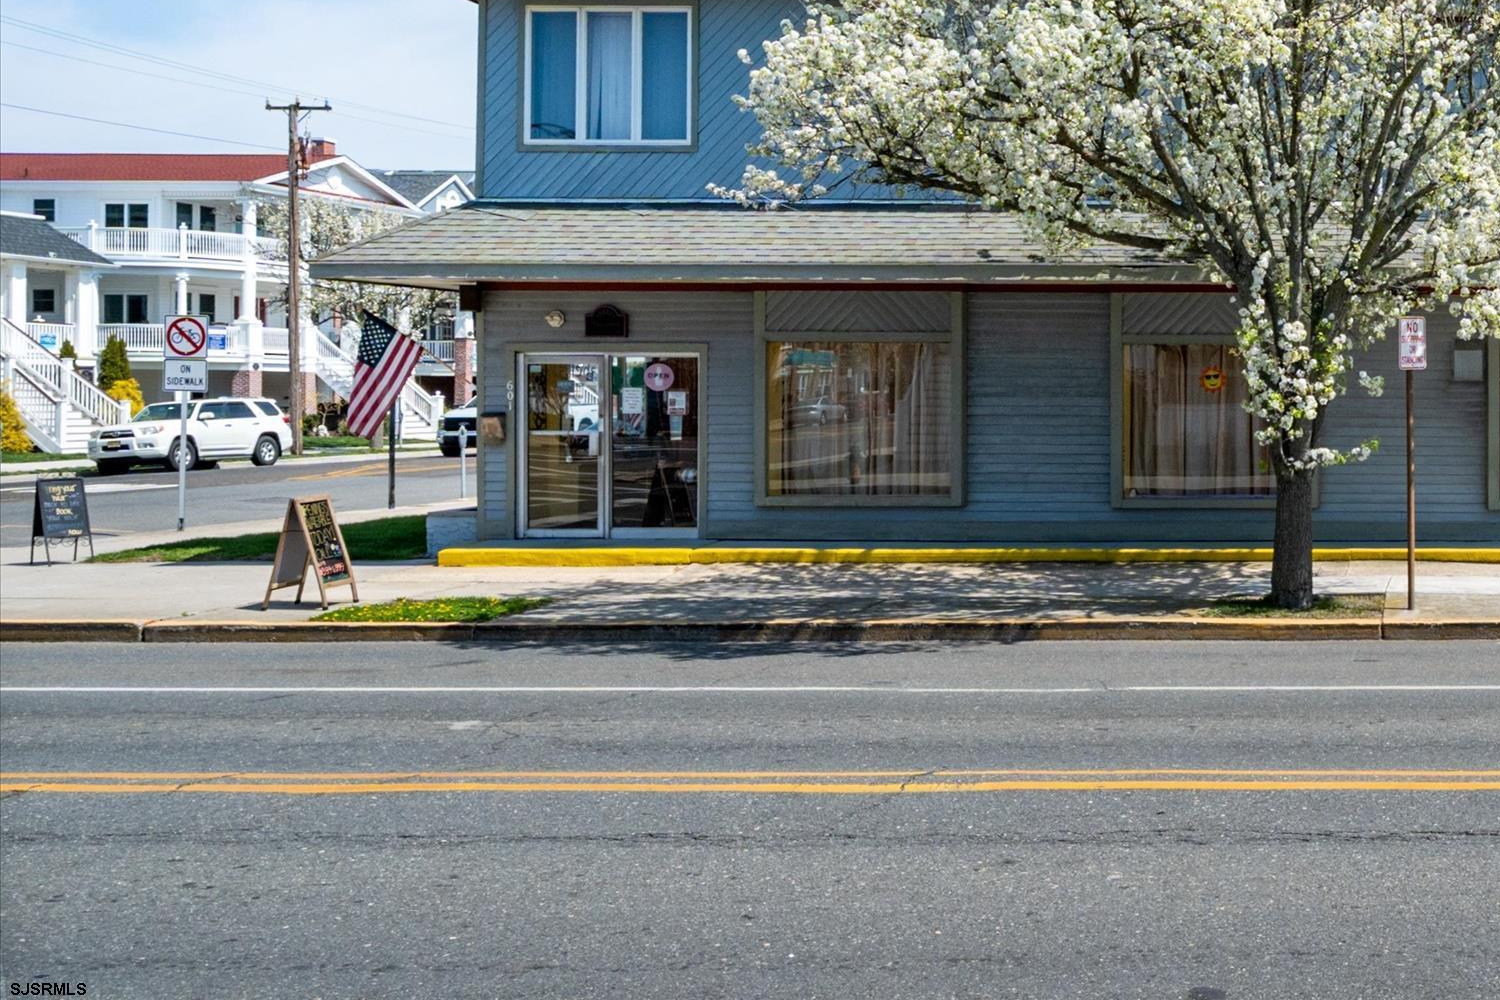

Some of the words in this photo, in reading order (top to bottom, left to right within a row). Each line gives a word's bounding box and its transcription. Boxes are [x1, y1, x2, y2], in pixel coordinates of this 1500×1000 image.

[1406, 321, 1419, 333] NO
[179, 364, 191, 374] ON
[166, 377, 204, 386] SIDEWALK
[506, 380, 514, 411] 601
